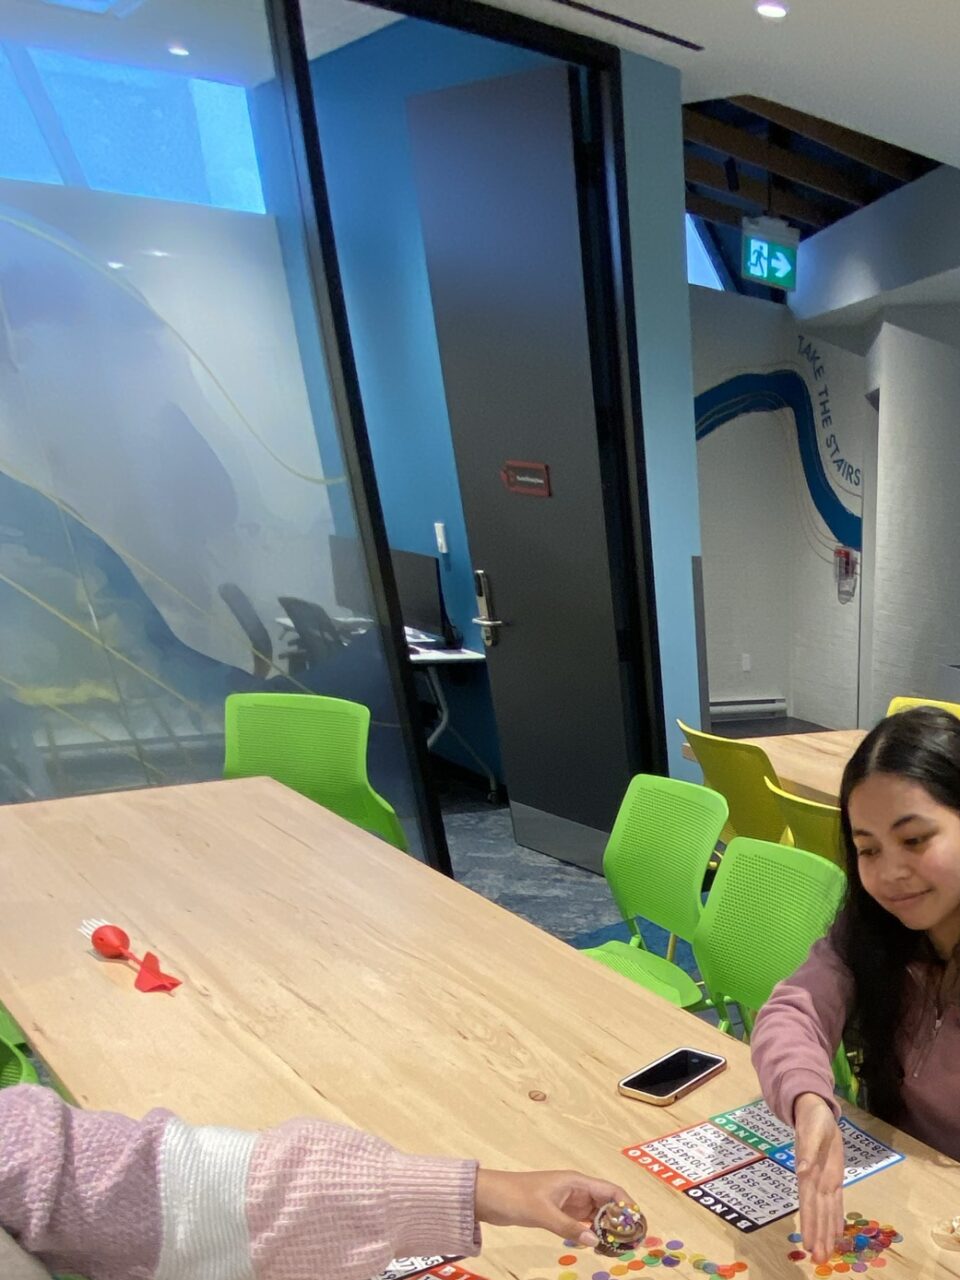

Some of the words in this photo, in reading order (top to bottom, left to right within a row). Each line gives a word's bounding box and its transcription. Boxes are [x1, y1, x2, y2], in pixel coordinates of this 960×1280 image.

[797, 335, 825, 380] TAKE
[818, 386, 832, 427] THE
[826, 435, 861, 486] STAIRS
